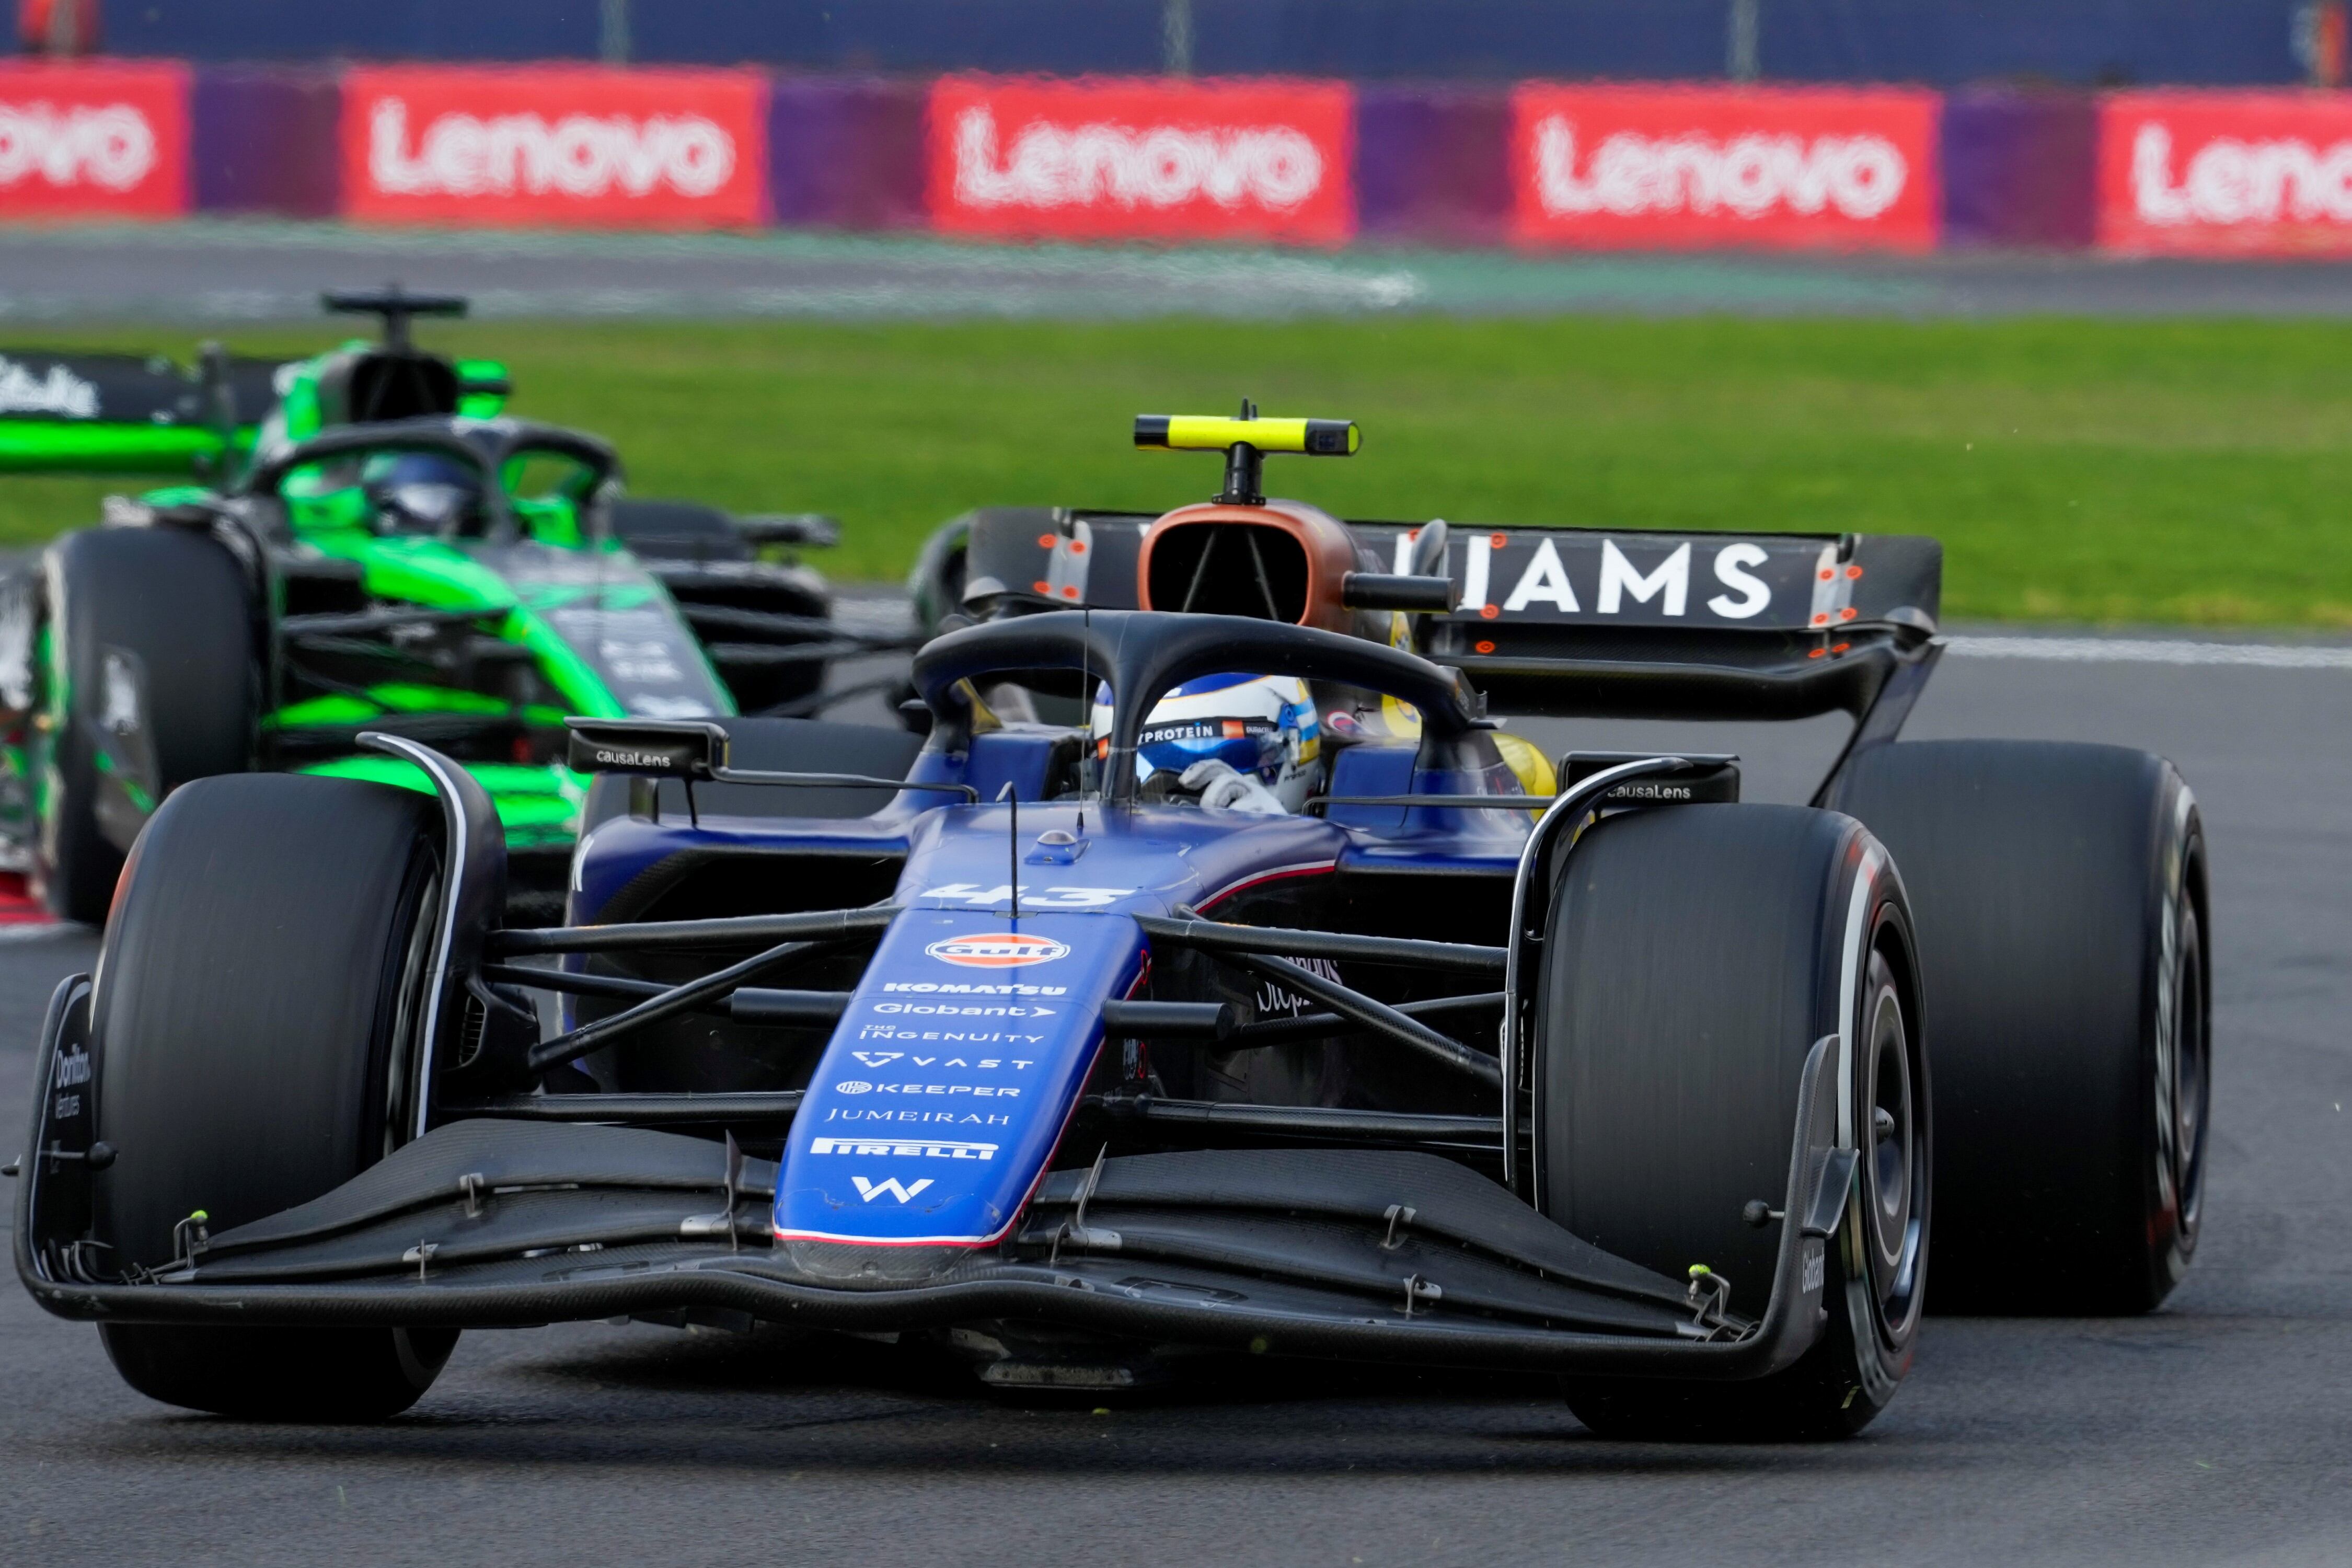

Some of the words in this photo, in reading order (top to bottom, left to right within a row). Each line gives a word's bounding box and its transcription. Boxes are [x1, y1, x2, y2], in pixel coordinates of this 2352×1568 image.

[369, 96, 735, 197] Lenovo
[953, 106, 1322, 211] Lenovo
[1534, 114, 1908, 218] Lenovo
[596, 750, 671, 767] causaLens
[920, 883, 1136, 907] 43
[938, 944, 1060, 957] Gulf
[883, 983, 1067, 995] KOMATSU
[873, 1002, 1028, 1016] Globant
[912, 1056, 1033, 1069] VAST
[877, 1083, 1021, 1097] KEEPER
[824, 1108, 1010, 1125] JUMEIRAH
[810, 1137, 999, 1160] PIRELLI
